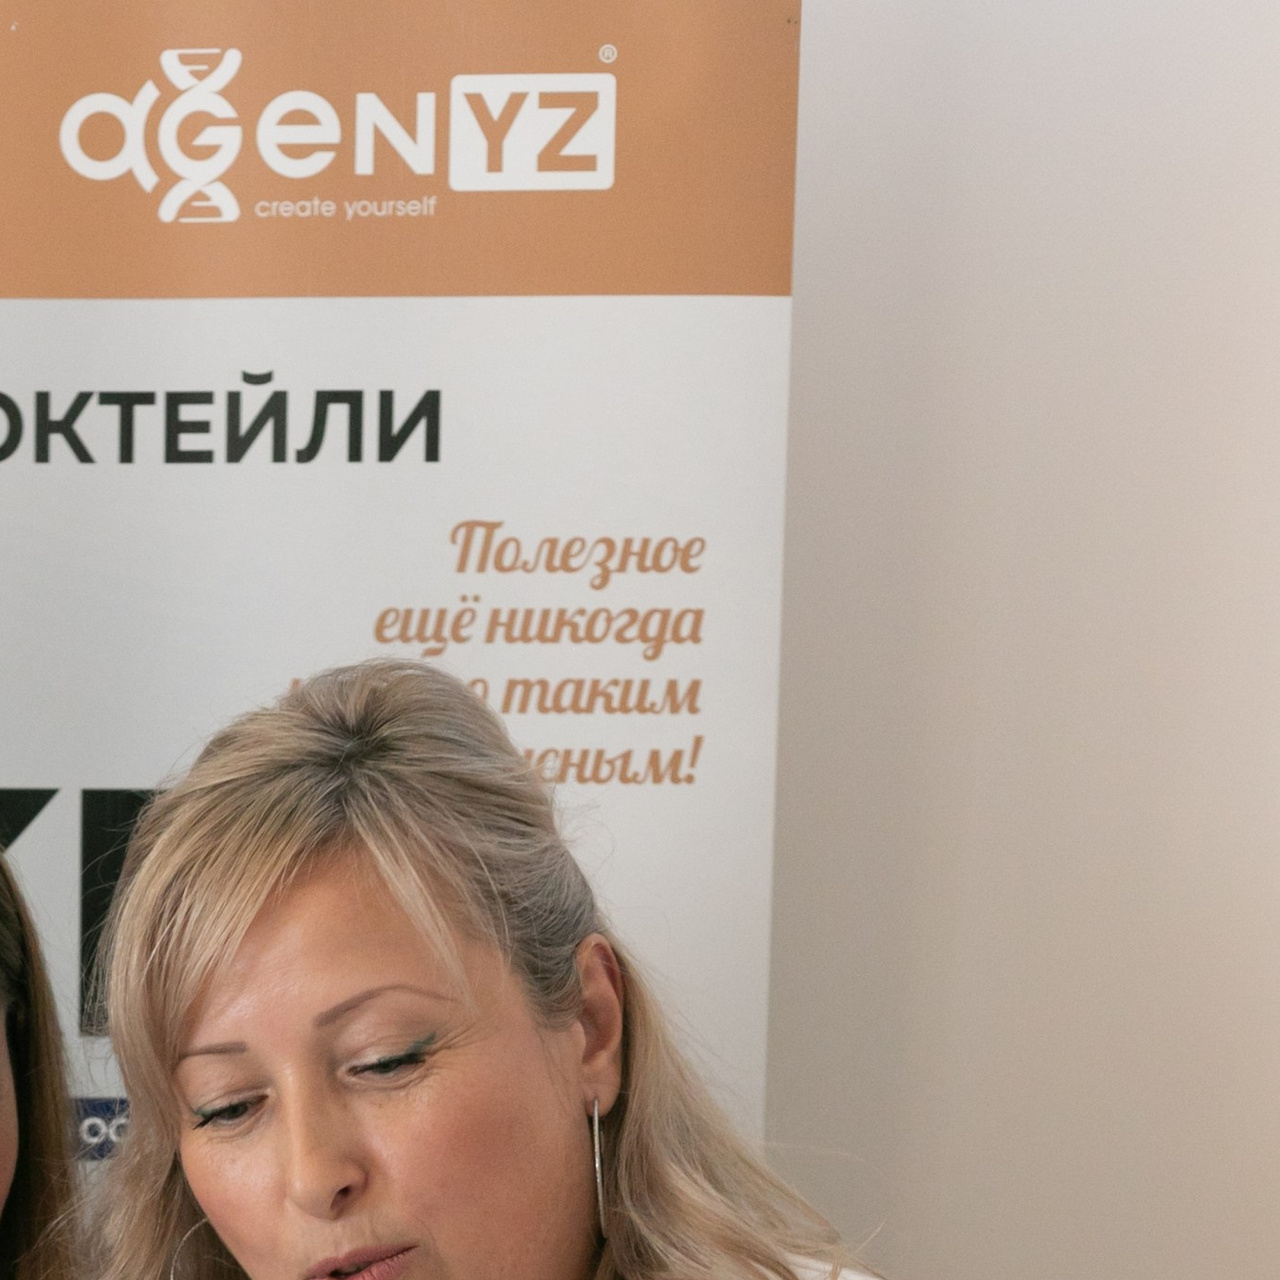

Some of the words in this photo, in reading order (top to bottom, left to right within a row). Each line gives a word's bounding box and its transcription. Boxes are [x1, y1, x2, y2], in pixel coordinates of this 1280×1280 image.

[254, 196, 337, 218] create
[344, 194, 437, 222] yourself
[450, 519, 707, 590] Полезное
[373, 595, 481, 657] ещё
[484, 607, 706, 661] никогда
[502, 678, 702, 715] таким
